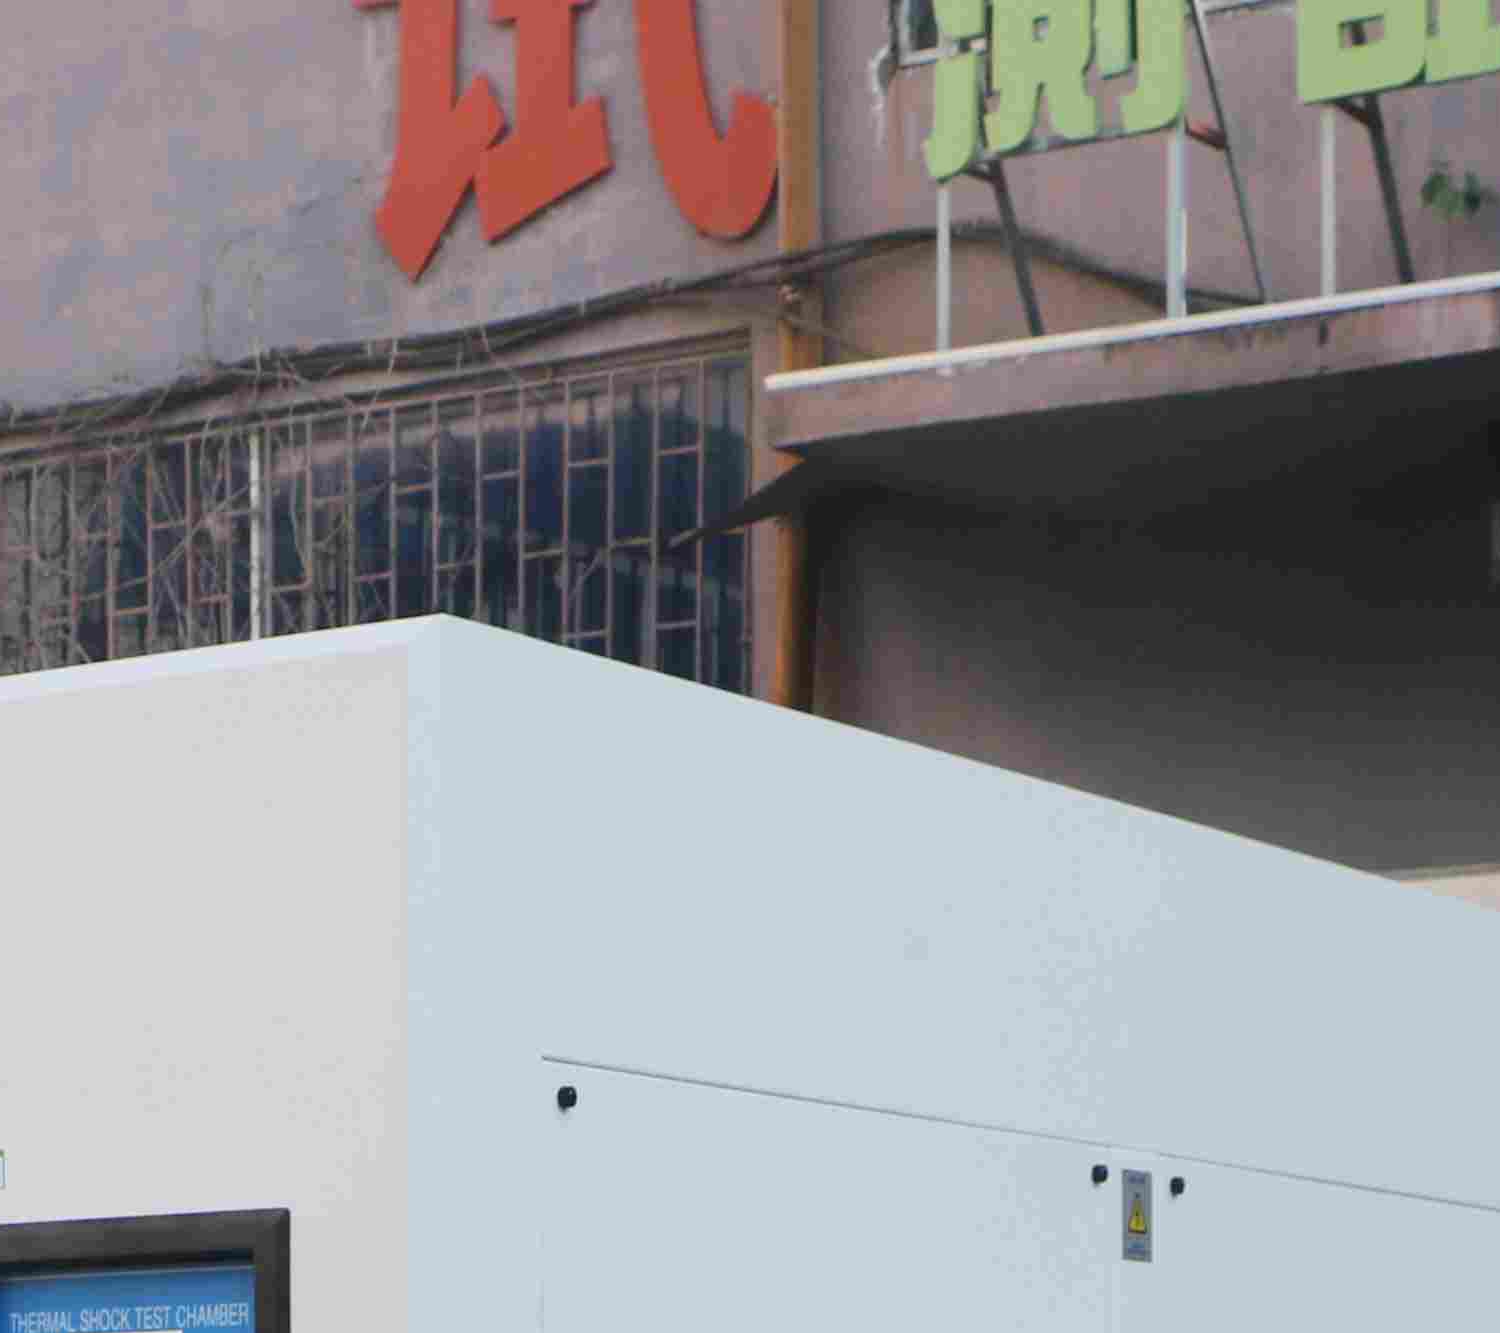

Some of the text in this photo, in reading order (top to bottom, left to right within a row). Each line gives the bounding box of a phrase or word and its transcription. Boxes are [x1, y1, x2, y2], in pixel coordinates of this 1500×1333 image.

[80, 1307, 132, 1332] SHOCK
[135, 1305, 171, 1329] TEST
[175, 1303, 249, 1329] CHAMBER
